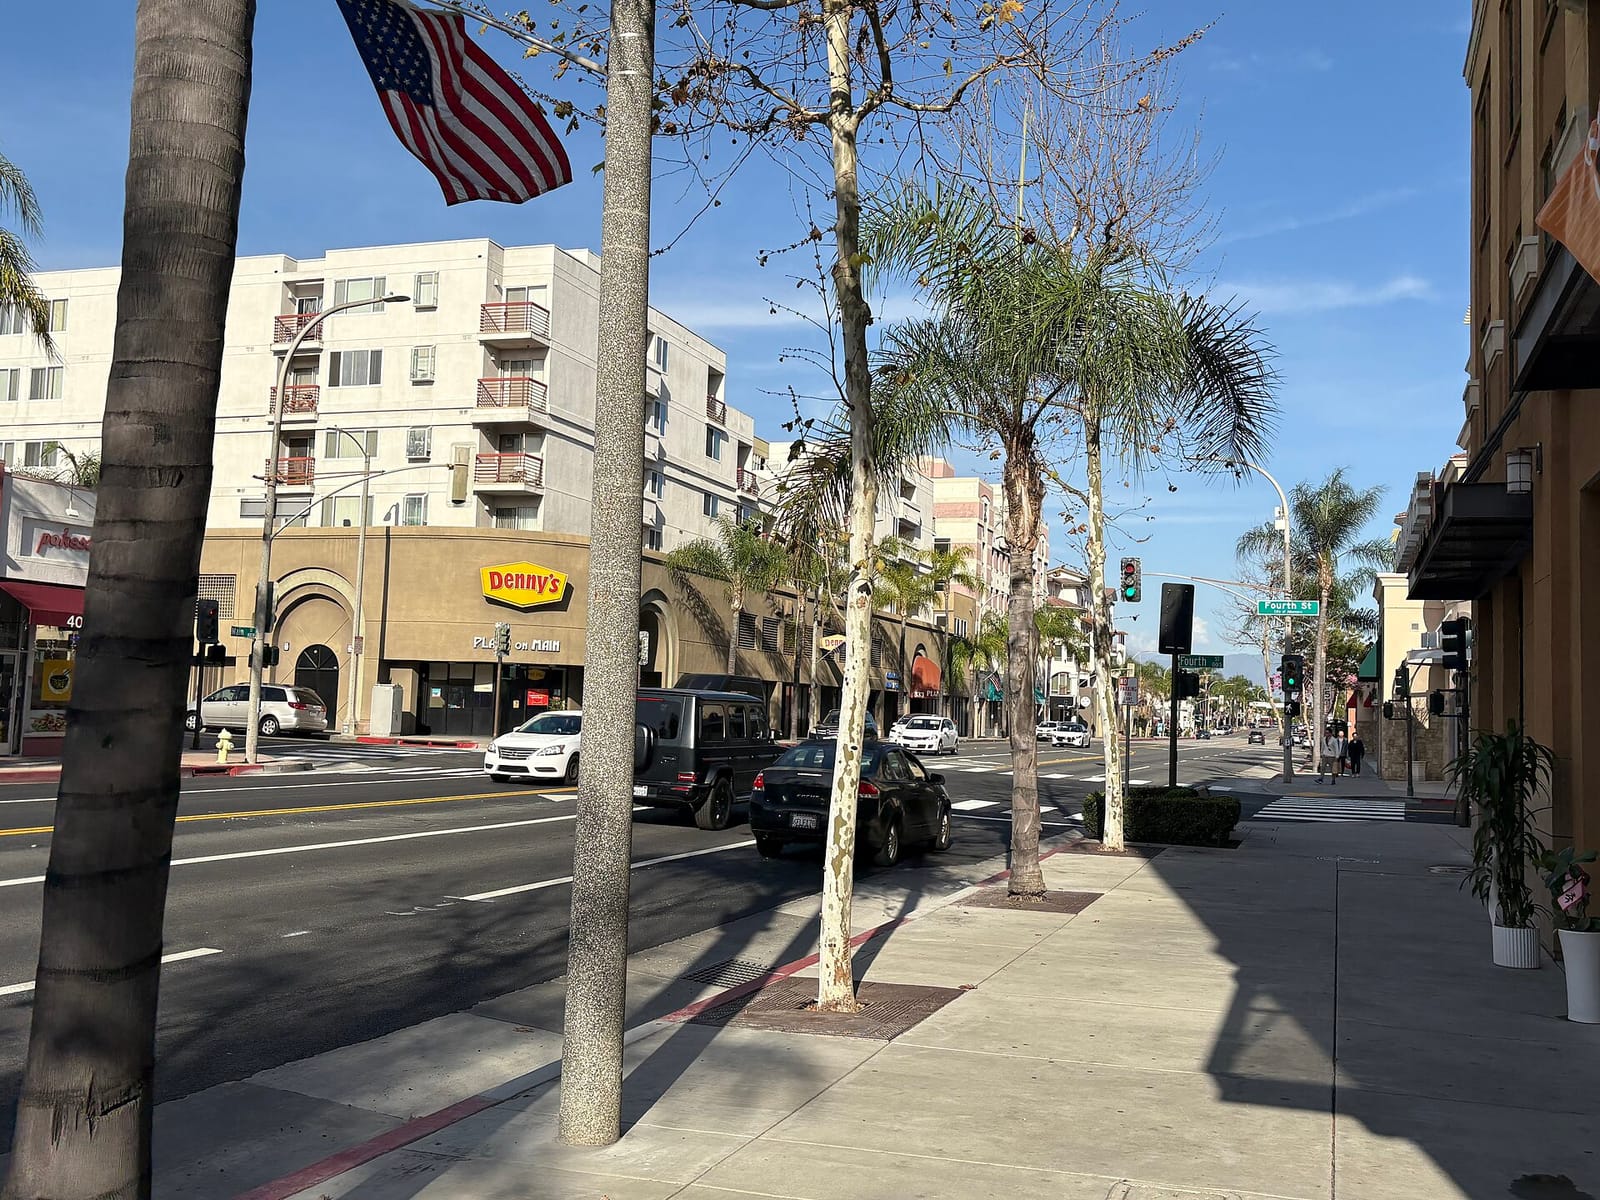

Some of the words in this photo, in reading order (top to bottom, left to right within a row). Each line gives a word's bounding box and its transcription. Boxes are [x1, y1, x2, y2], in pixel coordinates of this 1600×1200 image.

[489, 571, 560, 593] Denny's
[1264, 600, 1297, 610] Fourth
[1301, 602, 1312, 610] St
[531, 639, 560, 652] MAIN
[1180, 656, 1207, 667] Fourth
